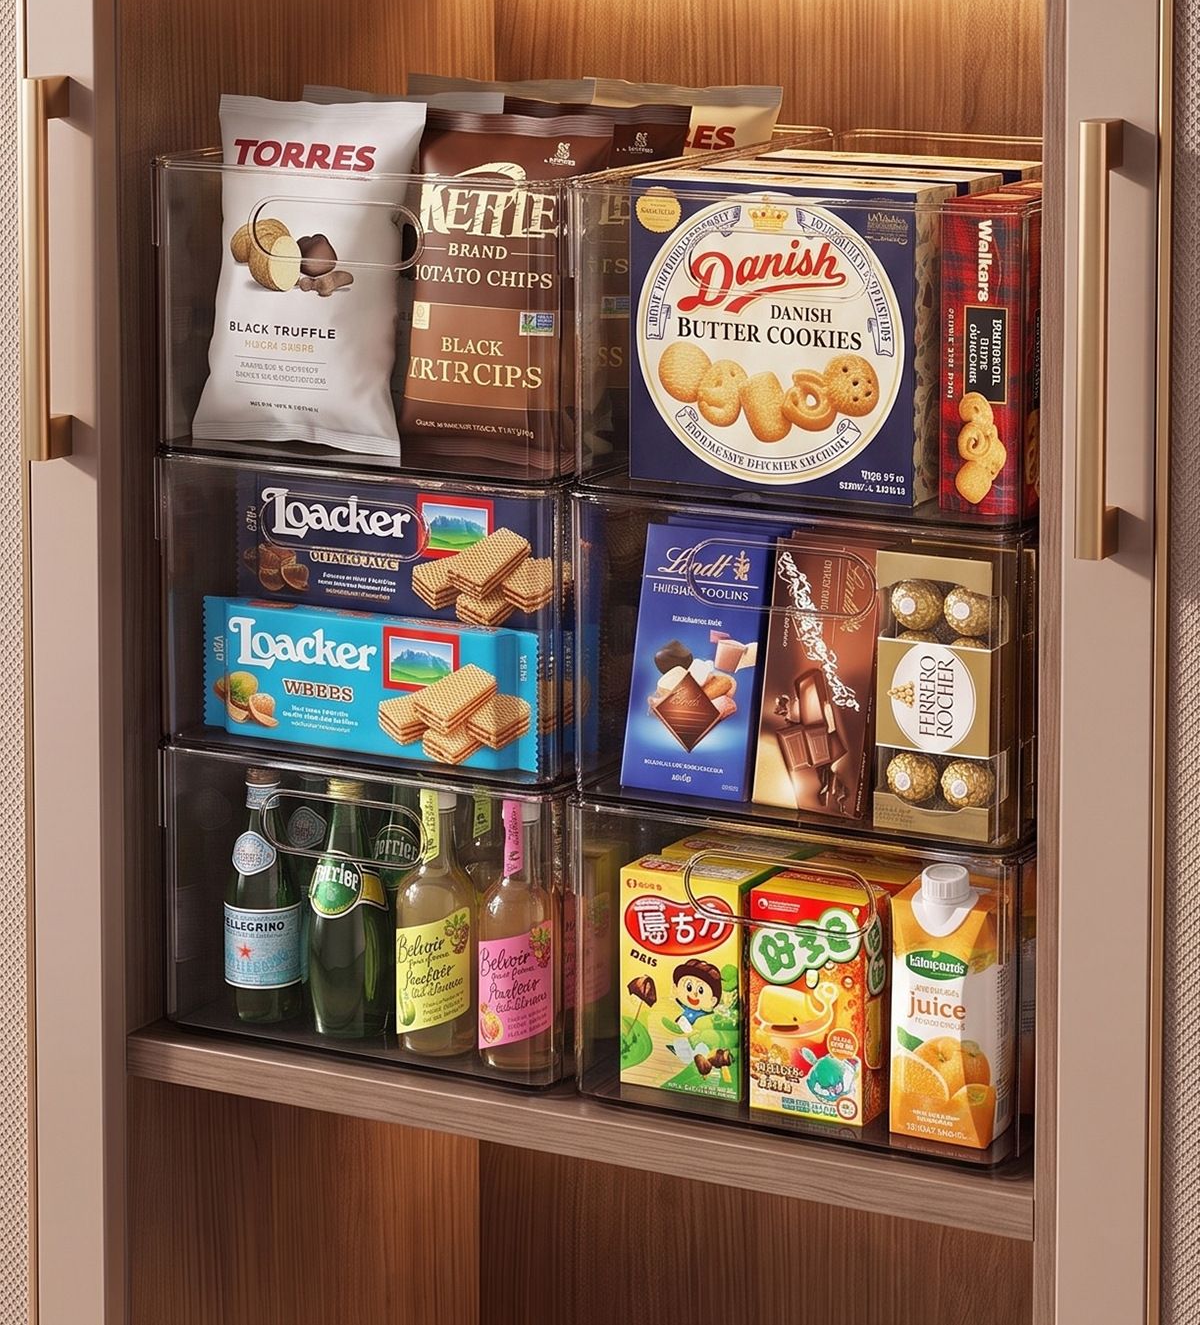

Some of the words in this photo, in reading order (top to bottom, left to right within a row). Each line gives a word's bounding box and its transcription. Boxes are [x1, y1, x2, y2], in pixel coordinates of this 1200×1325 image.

[233, 138, 376, 173] TORRES
[448, 243, 508, 260] BRAND
[487, 270, 553, 289] CHIPS
[677, 239, 846, 313] Danish
[229, 321, 269, 335] BLACK
[274, 325, 336, 339] TRUFFLE
[771, 304, 832, 324] DANISH
[441, 337, 504, 356] BLACK
[677, 317, 761, 343] BUTTER
[767, 326, 862, 350] COOKIES
[261, 487, 412, 539] Loacker
[228, 616, 377, 672] Loacker
[919, 655, 937, 737] FERRERO
[936, 657, 955, 739] ROCHER
[908, 990, 966, 1020] juice
